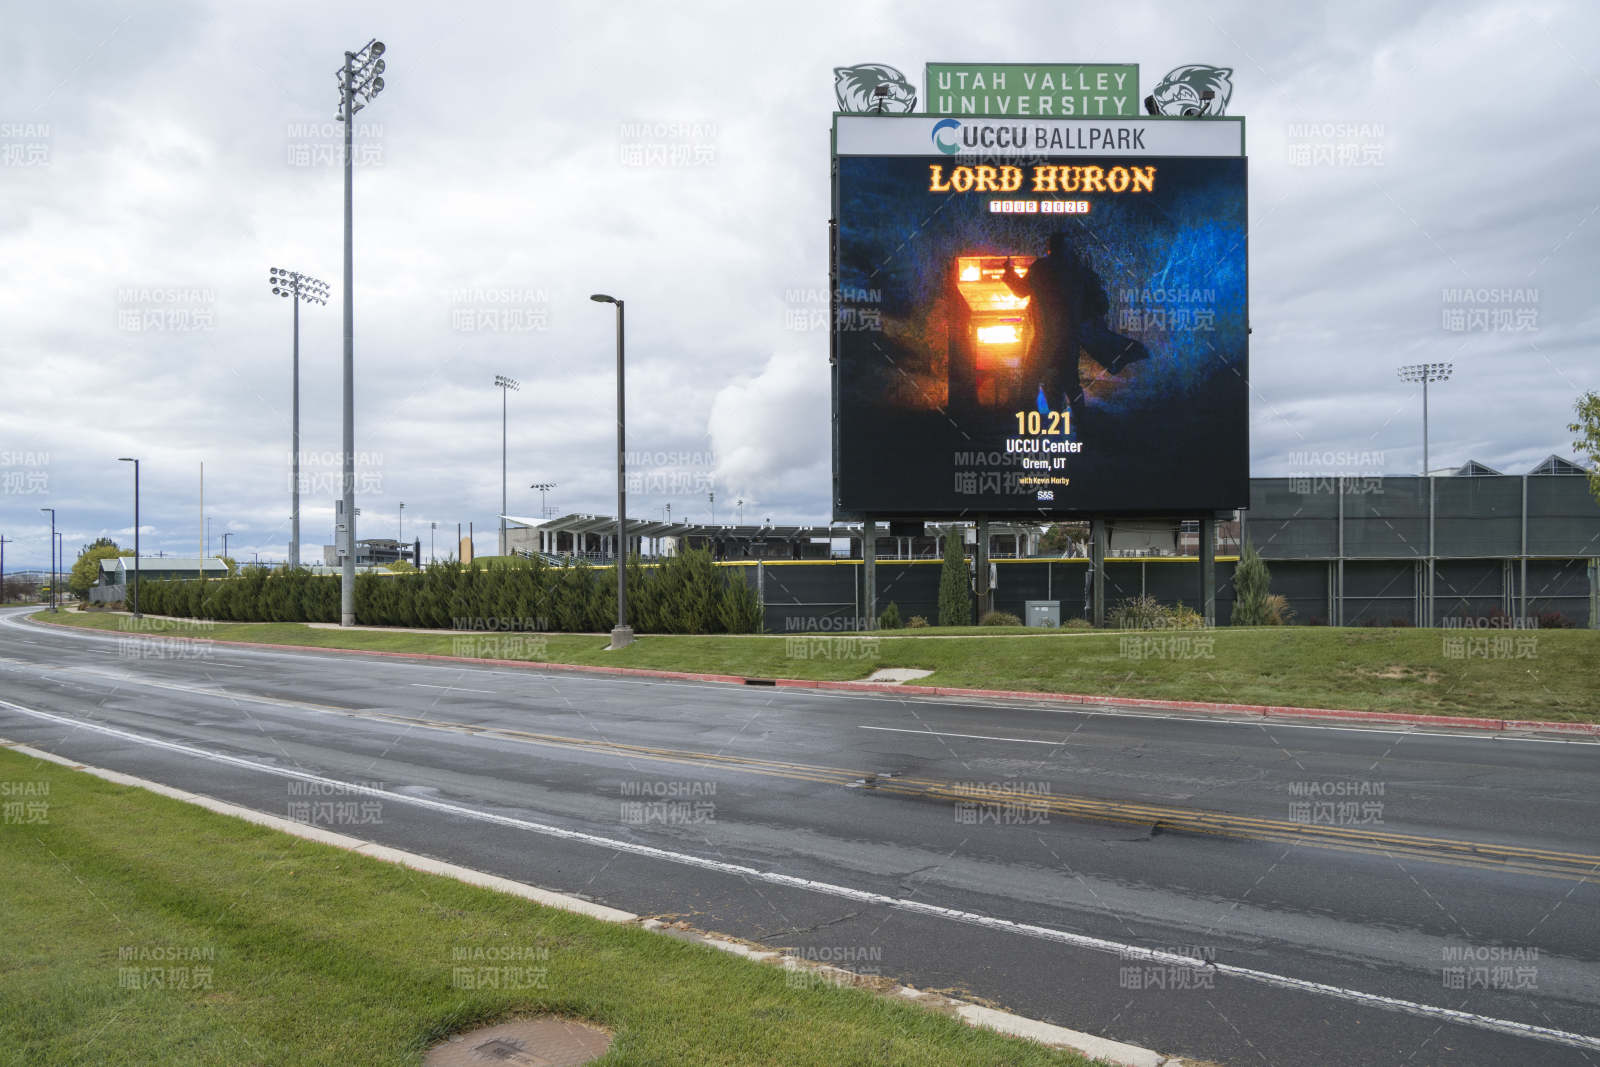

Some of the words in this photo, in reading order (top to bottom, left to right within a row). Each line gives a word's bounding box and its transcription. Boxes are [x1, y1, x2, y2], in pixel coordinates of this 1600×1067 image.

[938, 72, 1007, 91] UTAH
[1023, 72, 1128, 91] VALLEY
[938, 96, 1128, 115] UNIVERSITY
[962, 126, 1028, 149] UCCU
[1035, 127, 1146, 150] BALLPARK
[929, 165, 1024, 193] LORD
[1031, 165, 1156, 193] HURON
[991, 201, 1036, 212] TOUR
[1041, 201, 1087, 212] 2025
[1015, 410, 1071, 435] 10.21
[1006, 439, 1039, 453] UCCU
[1042, 439, 1083, 453] Center
[1022, 457, 1051, 471] Orem,
[1053, 457, 1067, 469] UT
[1019, 476, 1033, 485] with
